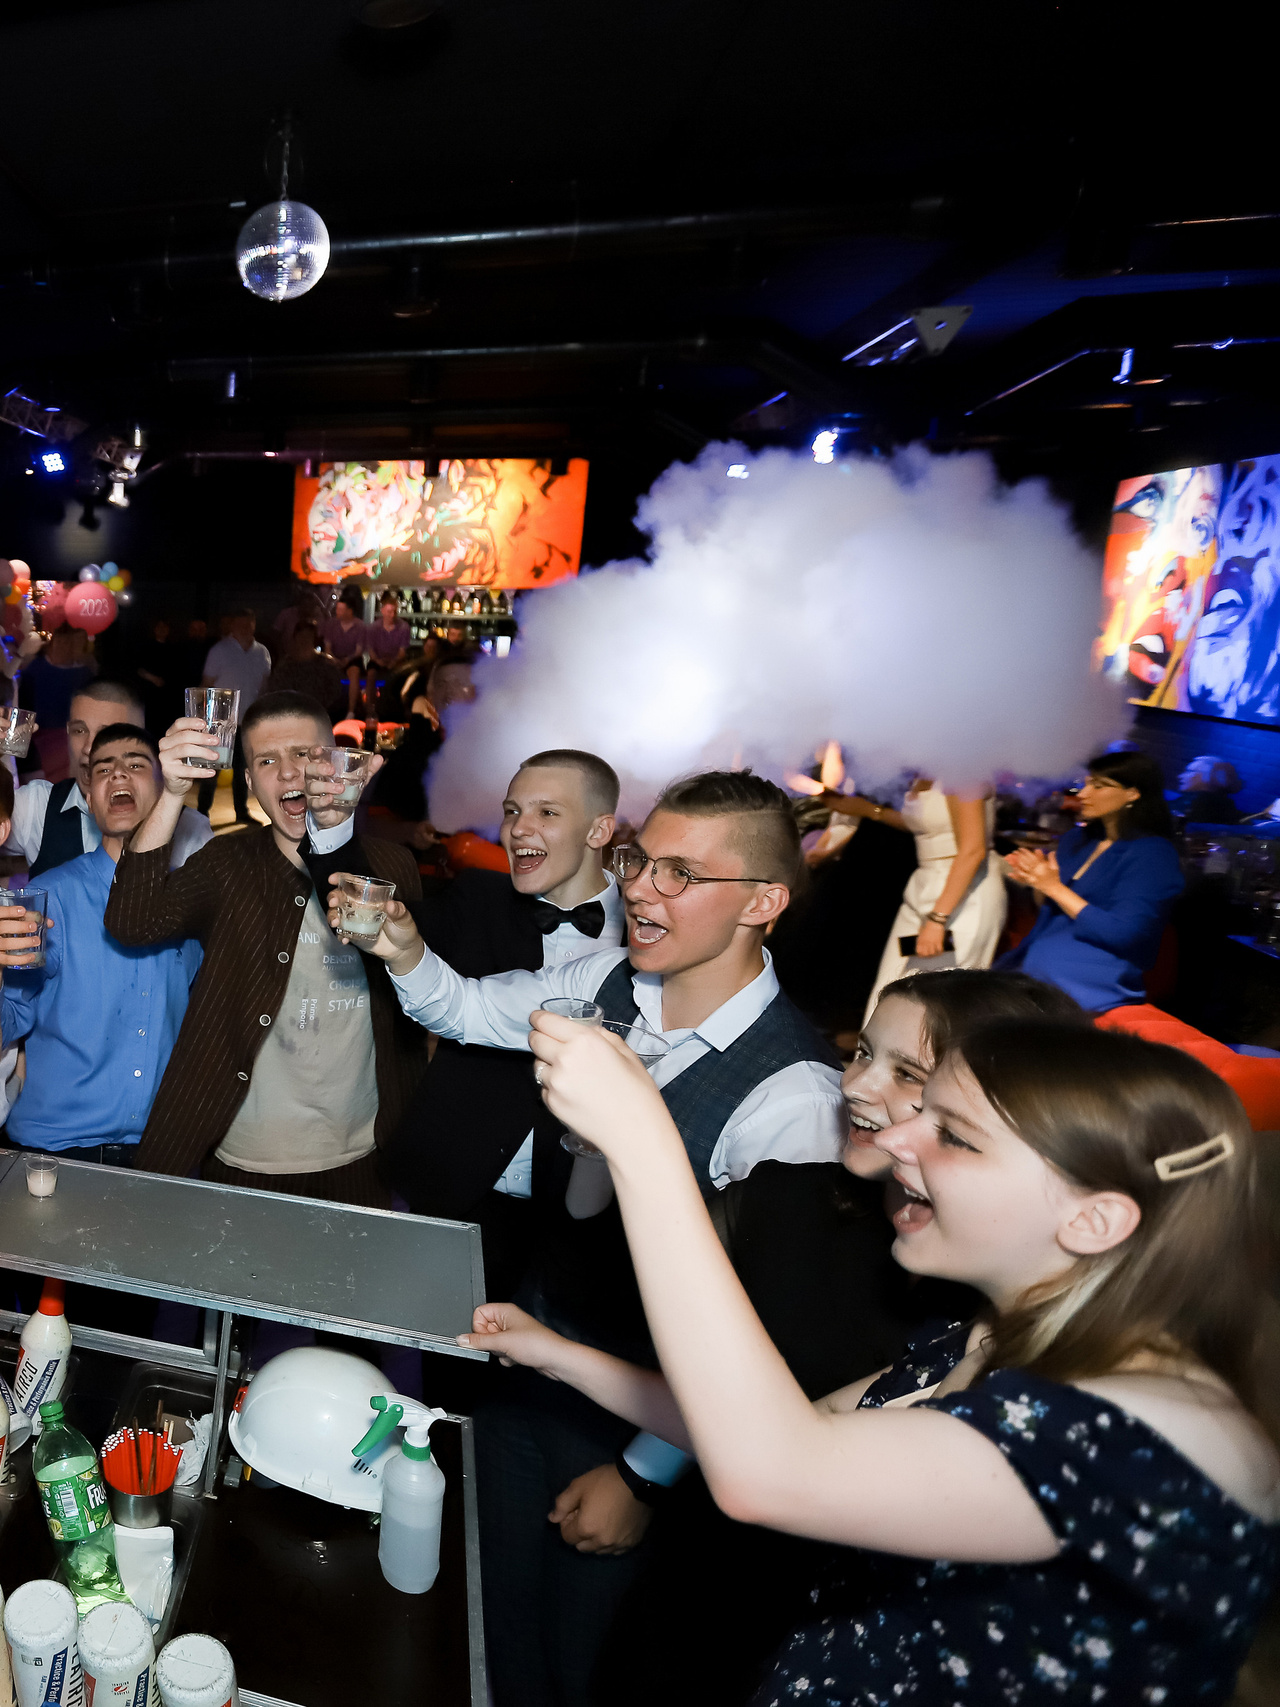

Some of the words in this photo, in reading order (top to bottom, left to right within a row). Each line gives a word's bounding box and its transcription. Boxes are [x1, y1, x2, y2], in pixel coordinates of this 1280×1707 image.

[79, 598, 110, 616] 2023
[322, 954, 357, 964] DENIM
[299, 998, 309, 1029] Emporio
[309, 998, 318, 1021] Primo
[328, 995, 365, 1012] STYLE
[52, 1653, 66, 1681] Practice
